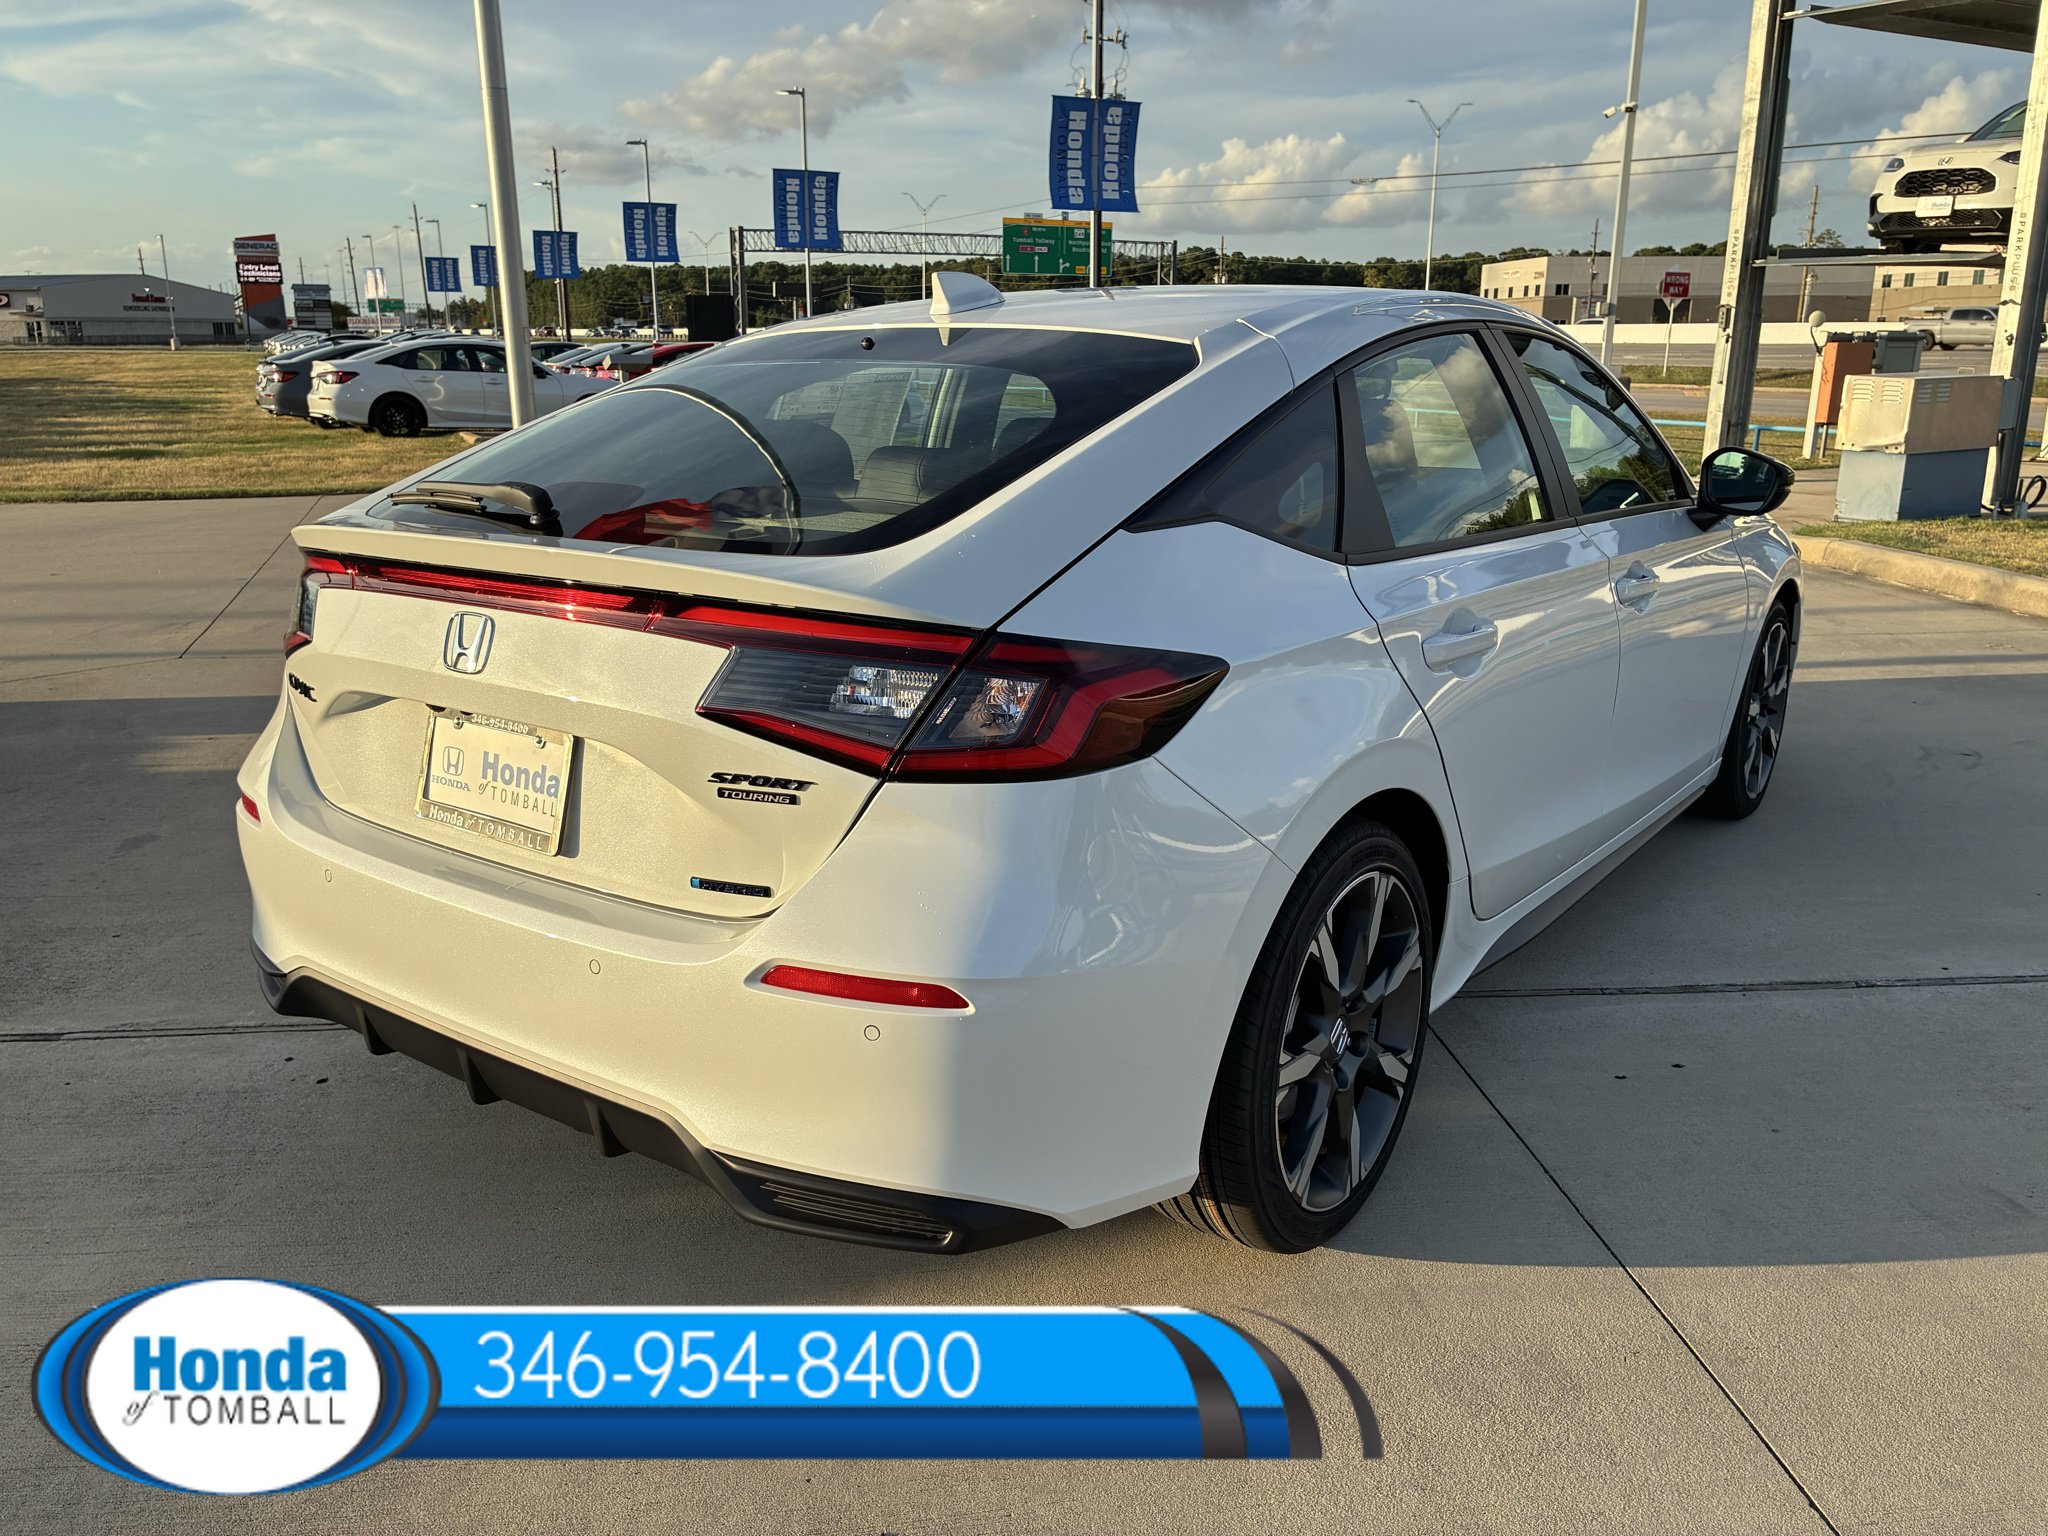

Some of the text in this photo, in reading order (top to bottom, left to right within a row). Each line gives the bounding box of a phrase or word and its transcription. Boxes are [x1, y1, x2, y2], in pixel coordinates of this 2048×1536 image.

[1056, 123, 1069, 203] TOMBALL
[1067, 110, 1087, 204] Honda
[1102, 106, 1123, 200] Honda
[786, 178, 801, 243] Honda
[813, 176, 828, 240] Honda
[633, 208, 647, 258] Honda
[655, 206, 669, 256] Honda
[541, 235, 553, 276] Honda
[560, 234, 571, 274] Honda
[1666, 275, 1689, 284] WRONG
[1669, 286, 1684, 294] WAY
[471, 713, 529, 735] 346-954-8400
[431, 774, 471, 792] HONDA
[481, 750, 561, 799] Honda
[706, 771, 819, 792] SPORT
[478, 781, 556, 818] of TOMBALL
[721, 789, 791, 804] TOURING
[428, 804, 464, 827] Honda
[477, 819, 542, 850] TOMBALL
